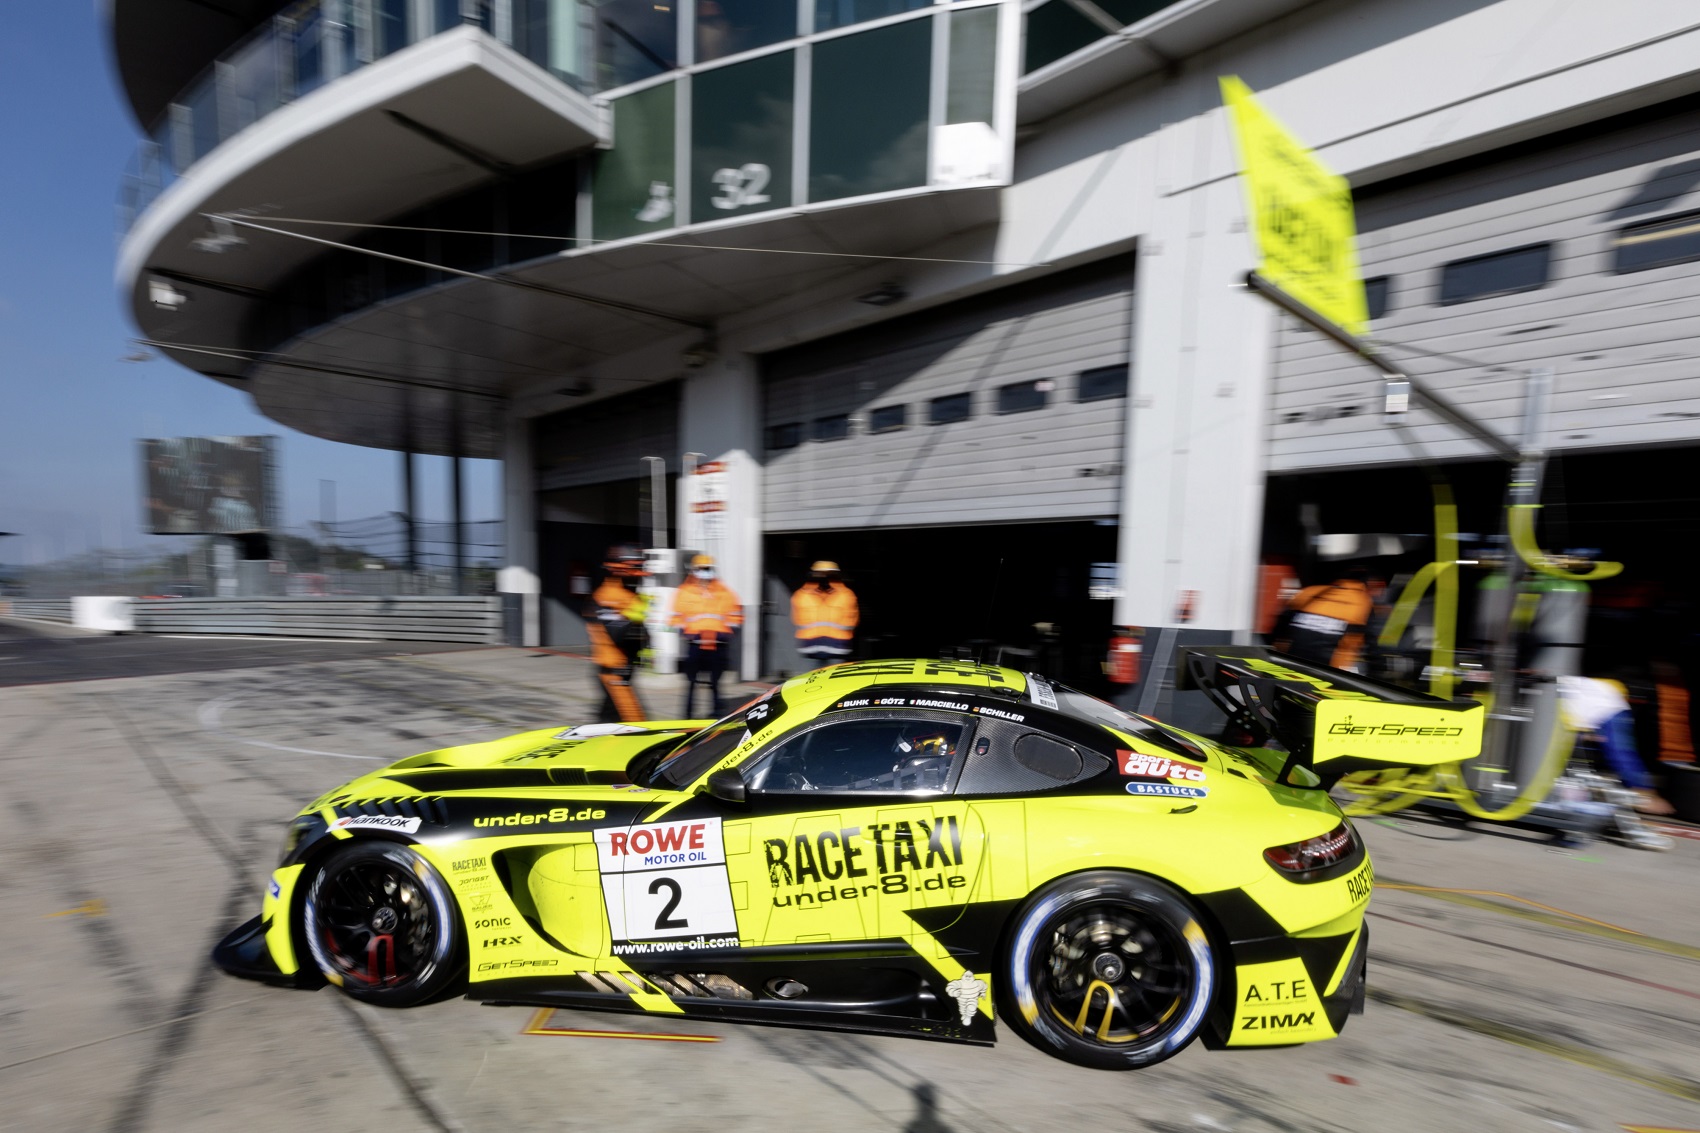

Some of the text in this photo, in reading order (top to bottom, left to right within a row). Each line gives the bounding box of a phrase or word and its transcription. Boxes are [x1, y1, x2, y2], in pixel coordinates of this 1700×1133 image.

[711, 163, 772, 210] 32
[843, 697, 1025, 722] BUHK GÖTZ MARCIELLO SCHILLER
[717, 729, 774, 772] der8.de
[1129, 752, 1172, 766] sport
[1124, 760, 1207, 782] auto
[1136, 784, 1199, 797] BASTUCK
[473, 808, 606, 828] under8.de
[608, 823, 706, 856] ROWE
[644, 851, 708, 866] MOTOR OIL
[772, 873, 967, 908] under8.de
[648, 877, 689, 931] 2
[482, 936, 523, 948] HRX
[612, 935, 739, 956] www.rowe-oil.com
[1245, 979, 1307, 1002] A.T.E
